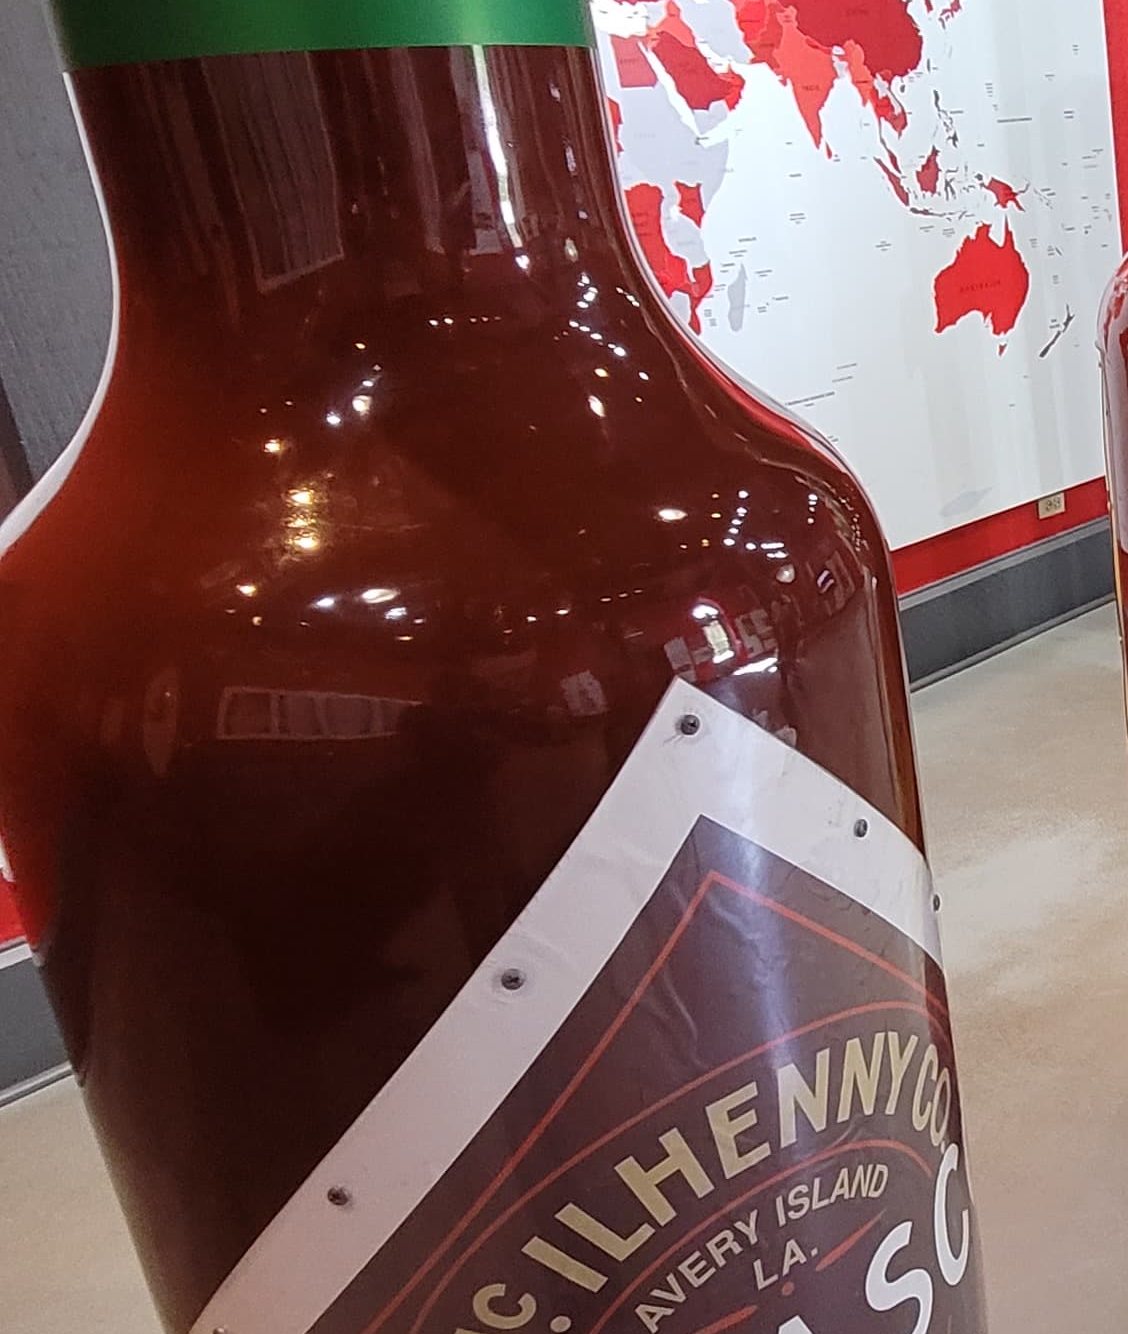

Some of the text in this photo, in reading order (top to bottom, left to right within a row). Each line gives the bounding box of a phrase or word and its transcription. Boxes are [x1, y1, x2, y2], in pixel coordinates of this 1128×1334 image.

[634, 1163, 889, 1334] AVERY ISLAND
[753, 1239, 818, 1291] LA.
